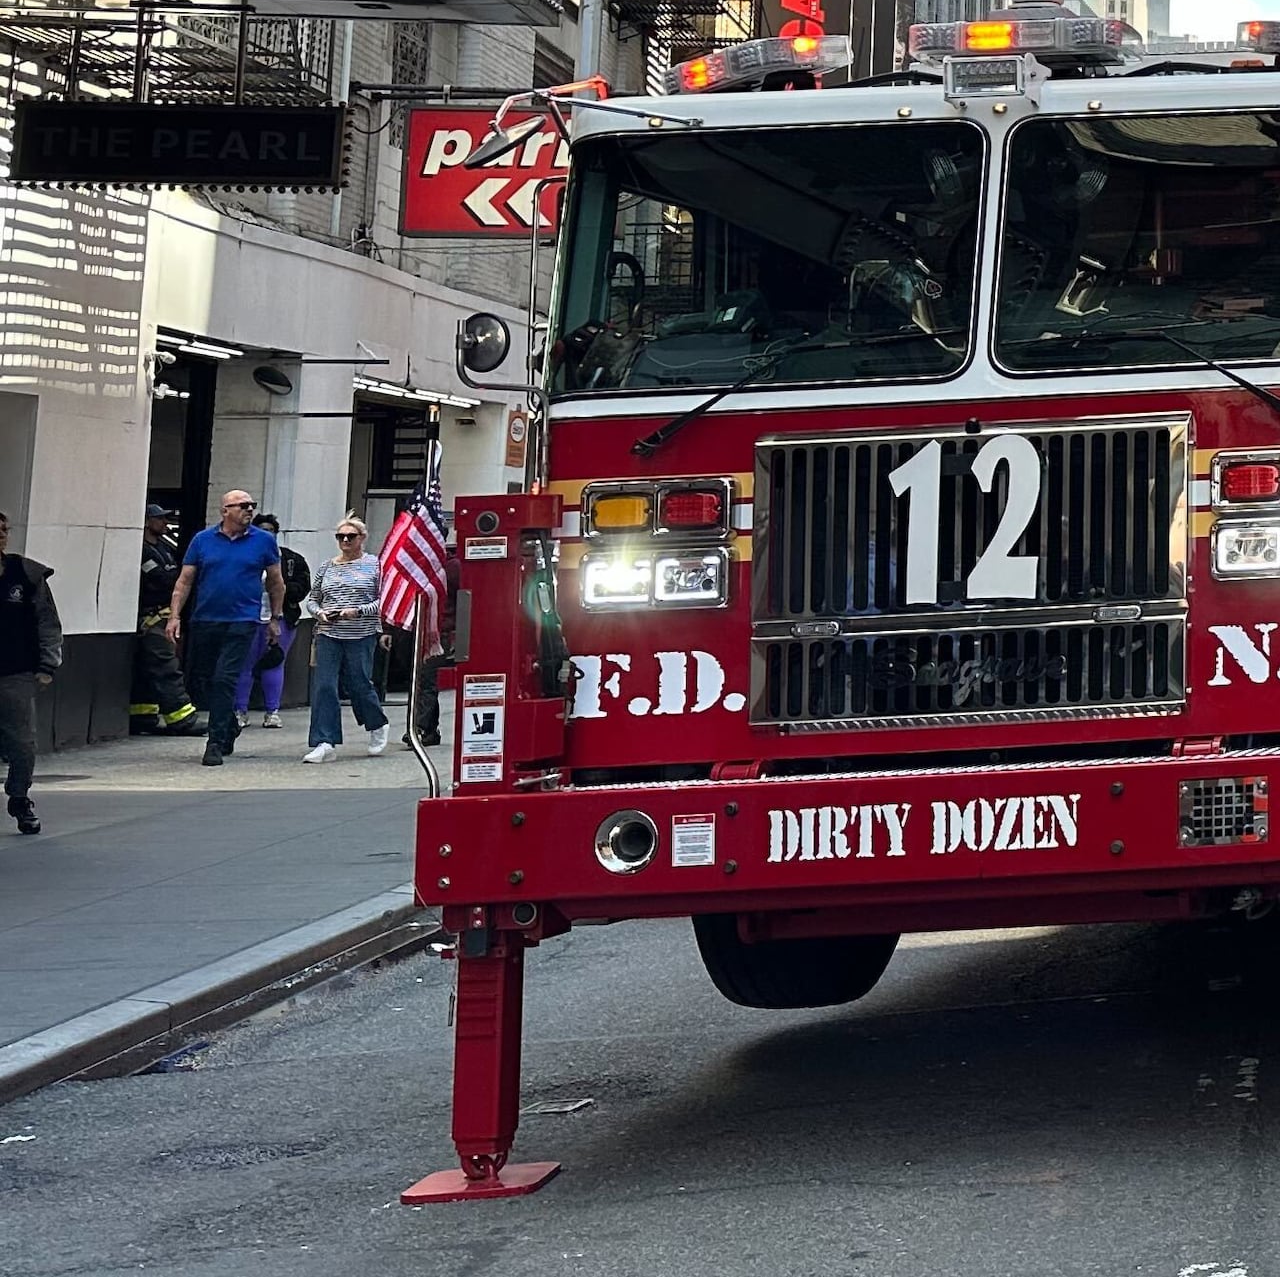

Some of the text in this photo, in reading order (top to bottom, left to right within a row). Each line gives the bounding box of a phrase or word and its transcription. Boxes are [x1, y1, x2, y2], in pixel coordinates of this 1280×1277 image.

[36, 127, 321, 161] THE PEARL
[888, 435, 1040, 606] 12
[566, 651, 747, 719] F.D.
[766, 802, 910, 863] DIRTY
[930, 793, 1080, 854] DOZEN
